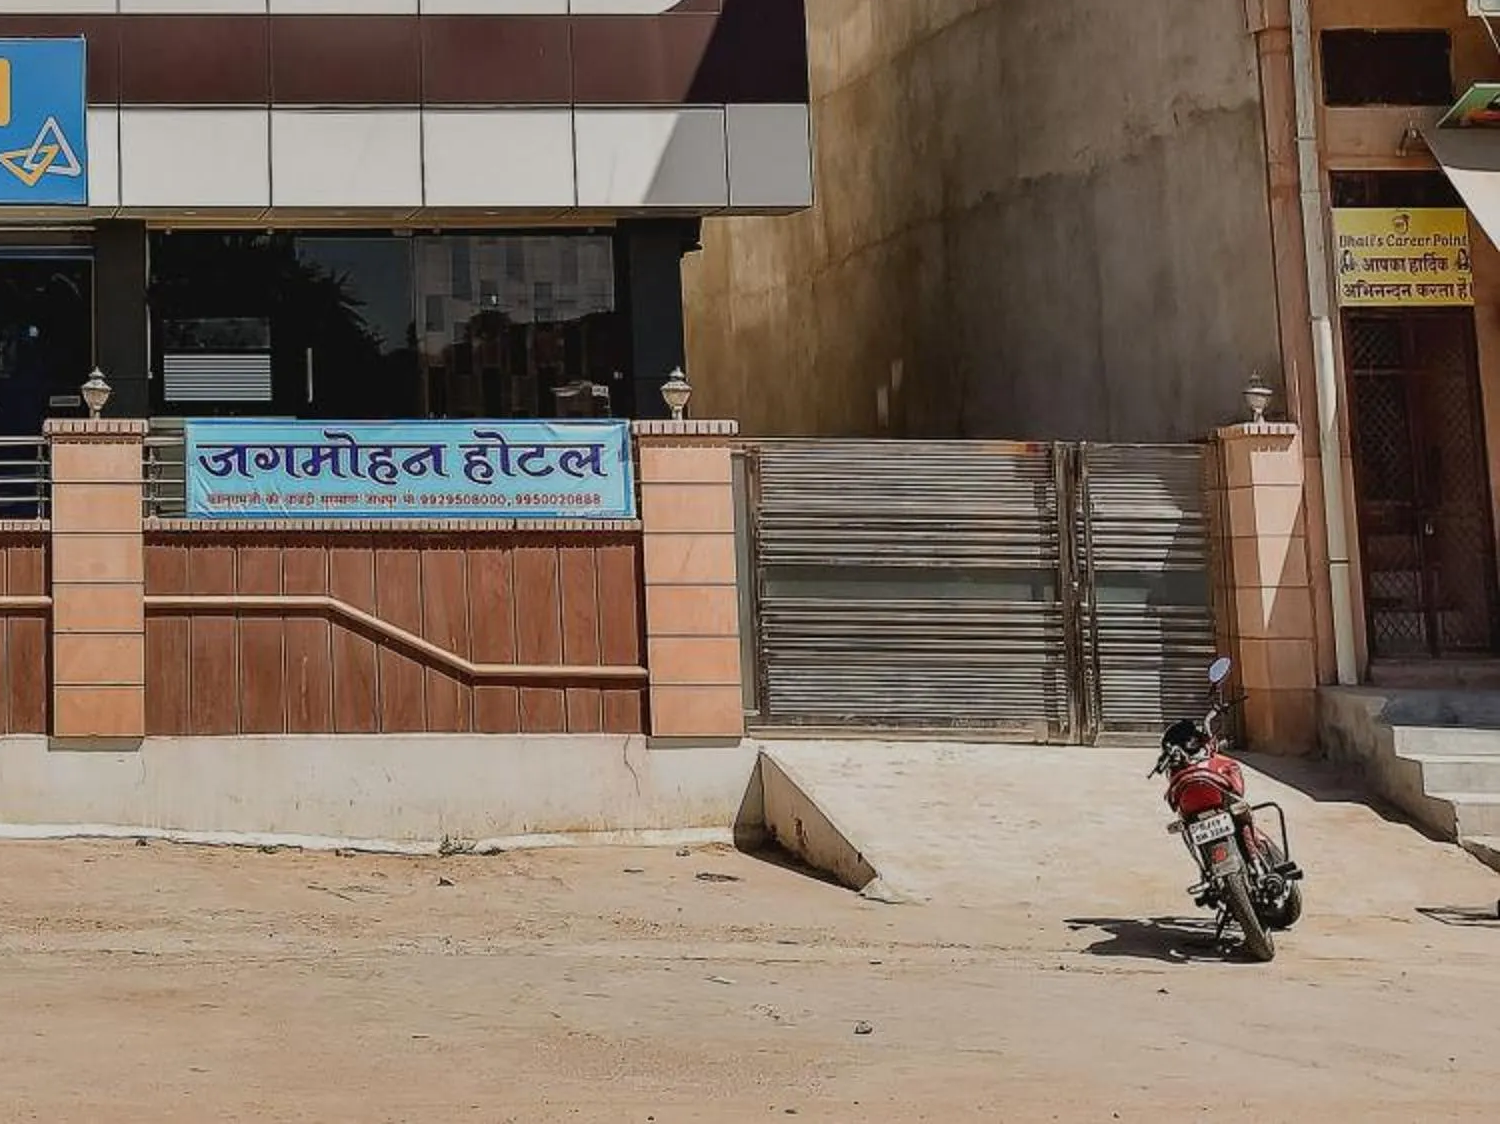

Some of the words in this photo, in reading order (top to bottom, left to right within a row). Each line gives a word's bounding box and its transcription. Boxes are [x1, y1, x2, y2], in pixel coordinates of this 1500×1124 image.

[1433, 235, 1467, 247] Point
[1416, 283, 1454, 297] करता
[196, 429, 447, 484] जगमोहन
[458, 429, 606, 484] होटल
